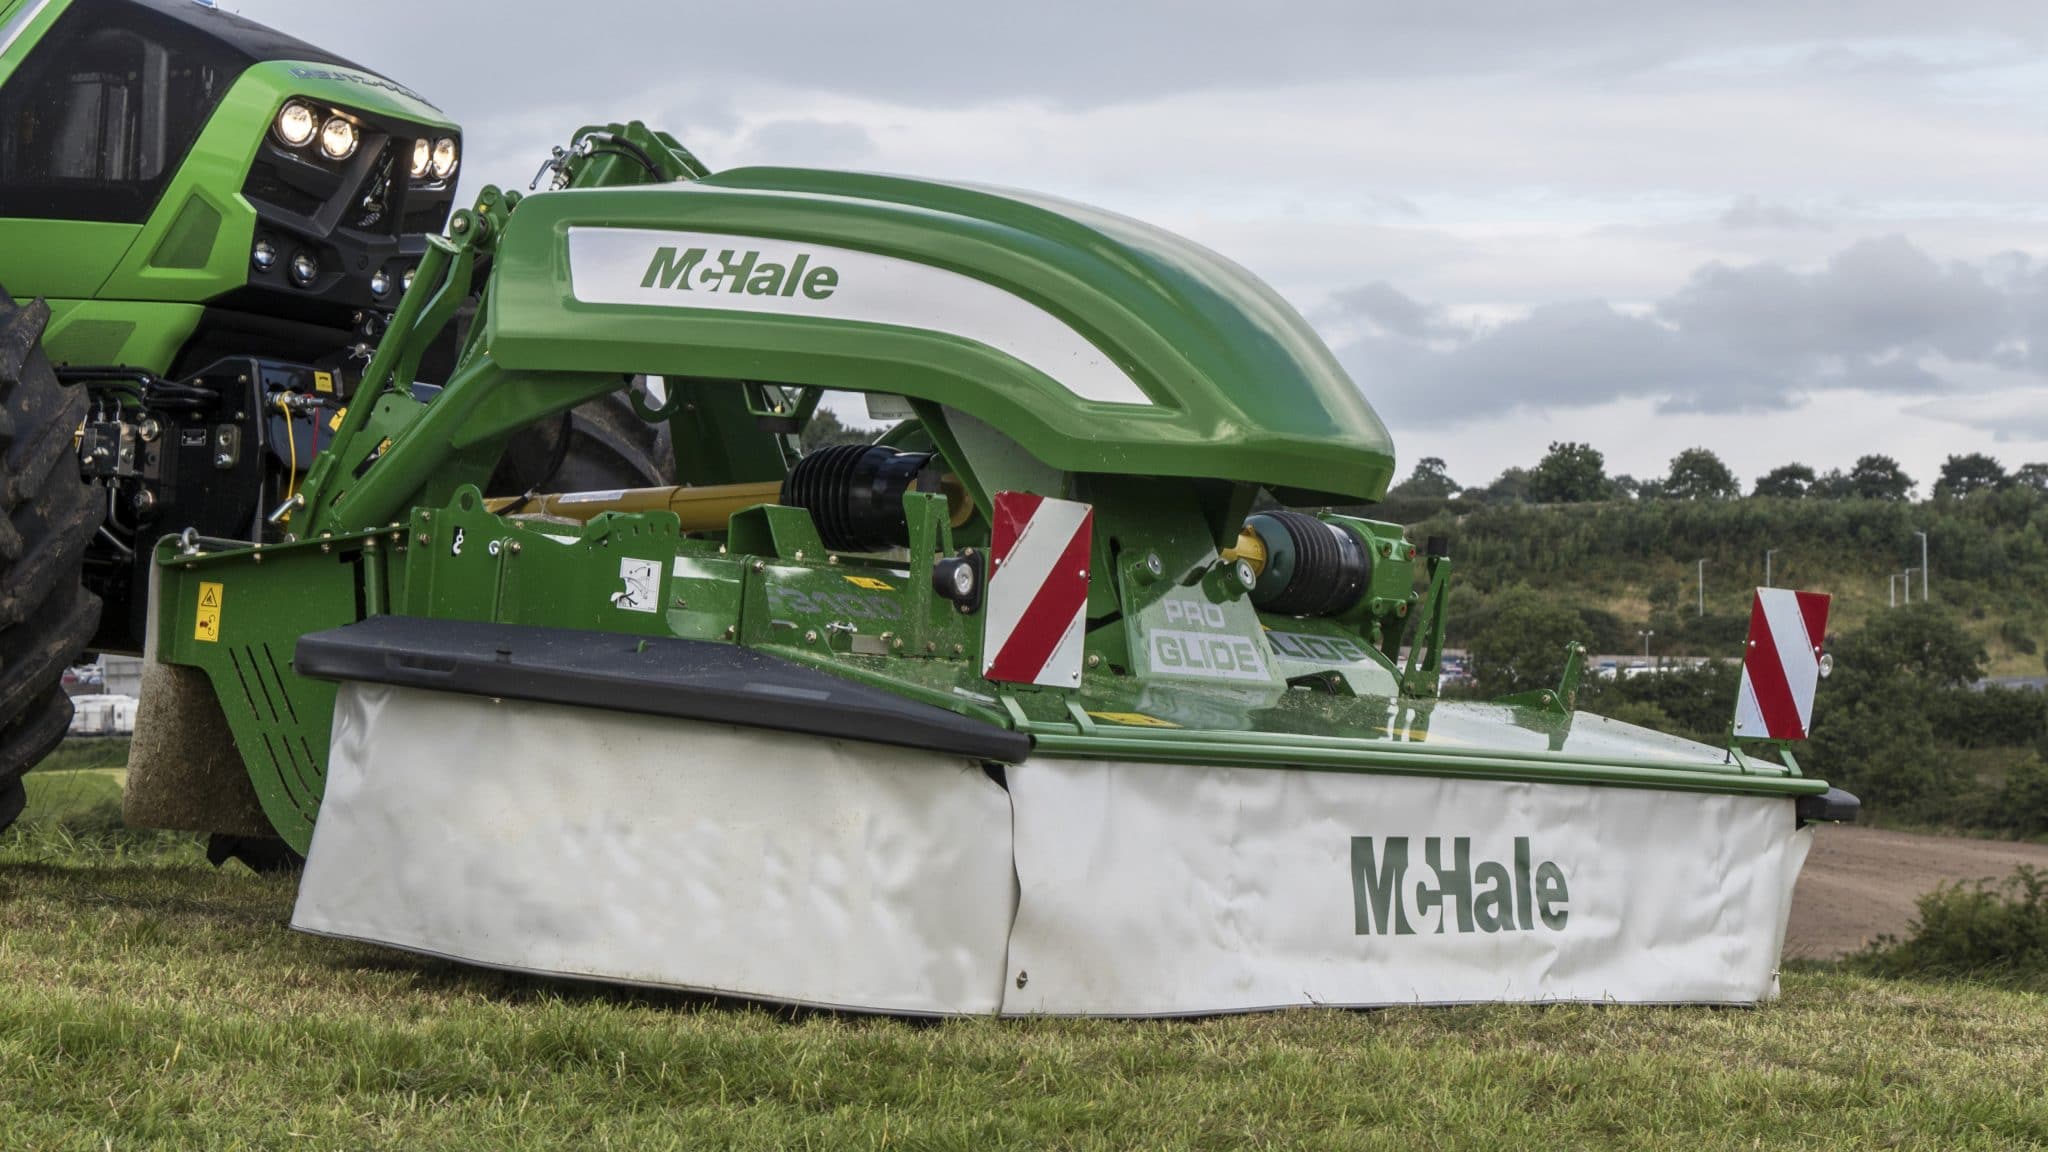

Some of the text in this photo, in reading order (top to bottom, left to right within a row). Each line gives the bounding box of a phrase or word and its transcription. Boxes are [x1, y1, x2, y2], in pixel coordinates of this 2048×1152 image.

[640, 246, 839, 300] McHale
[1163, 600, 1226, 629] PRO
[1155, 635, 1260, 673] GLIDE
[1266, 632, 1366, 662] LIDE
[1350, 836, 1569, 936] McHale
